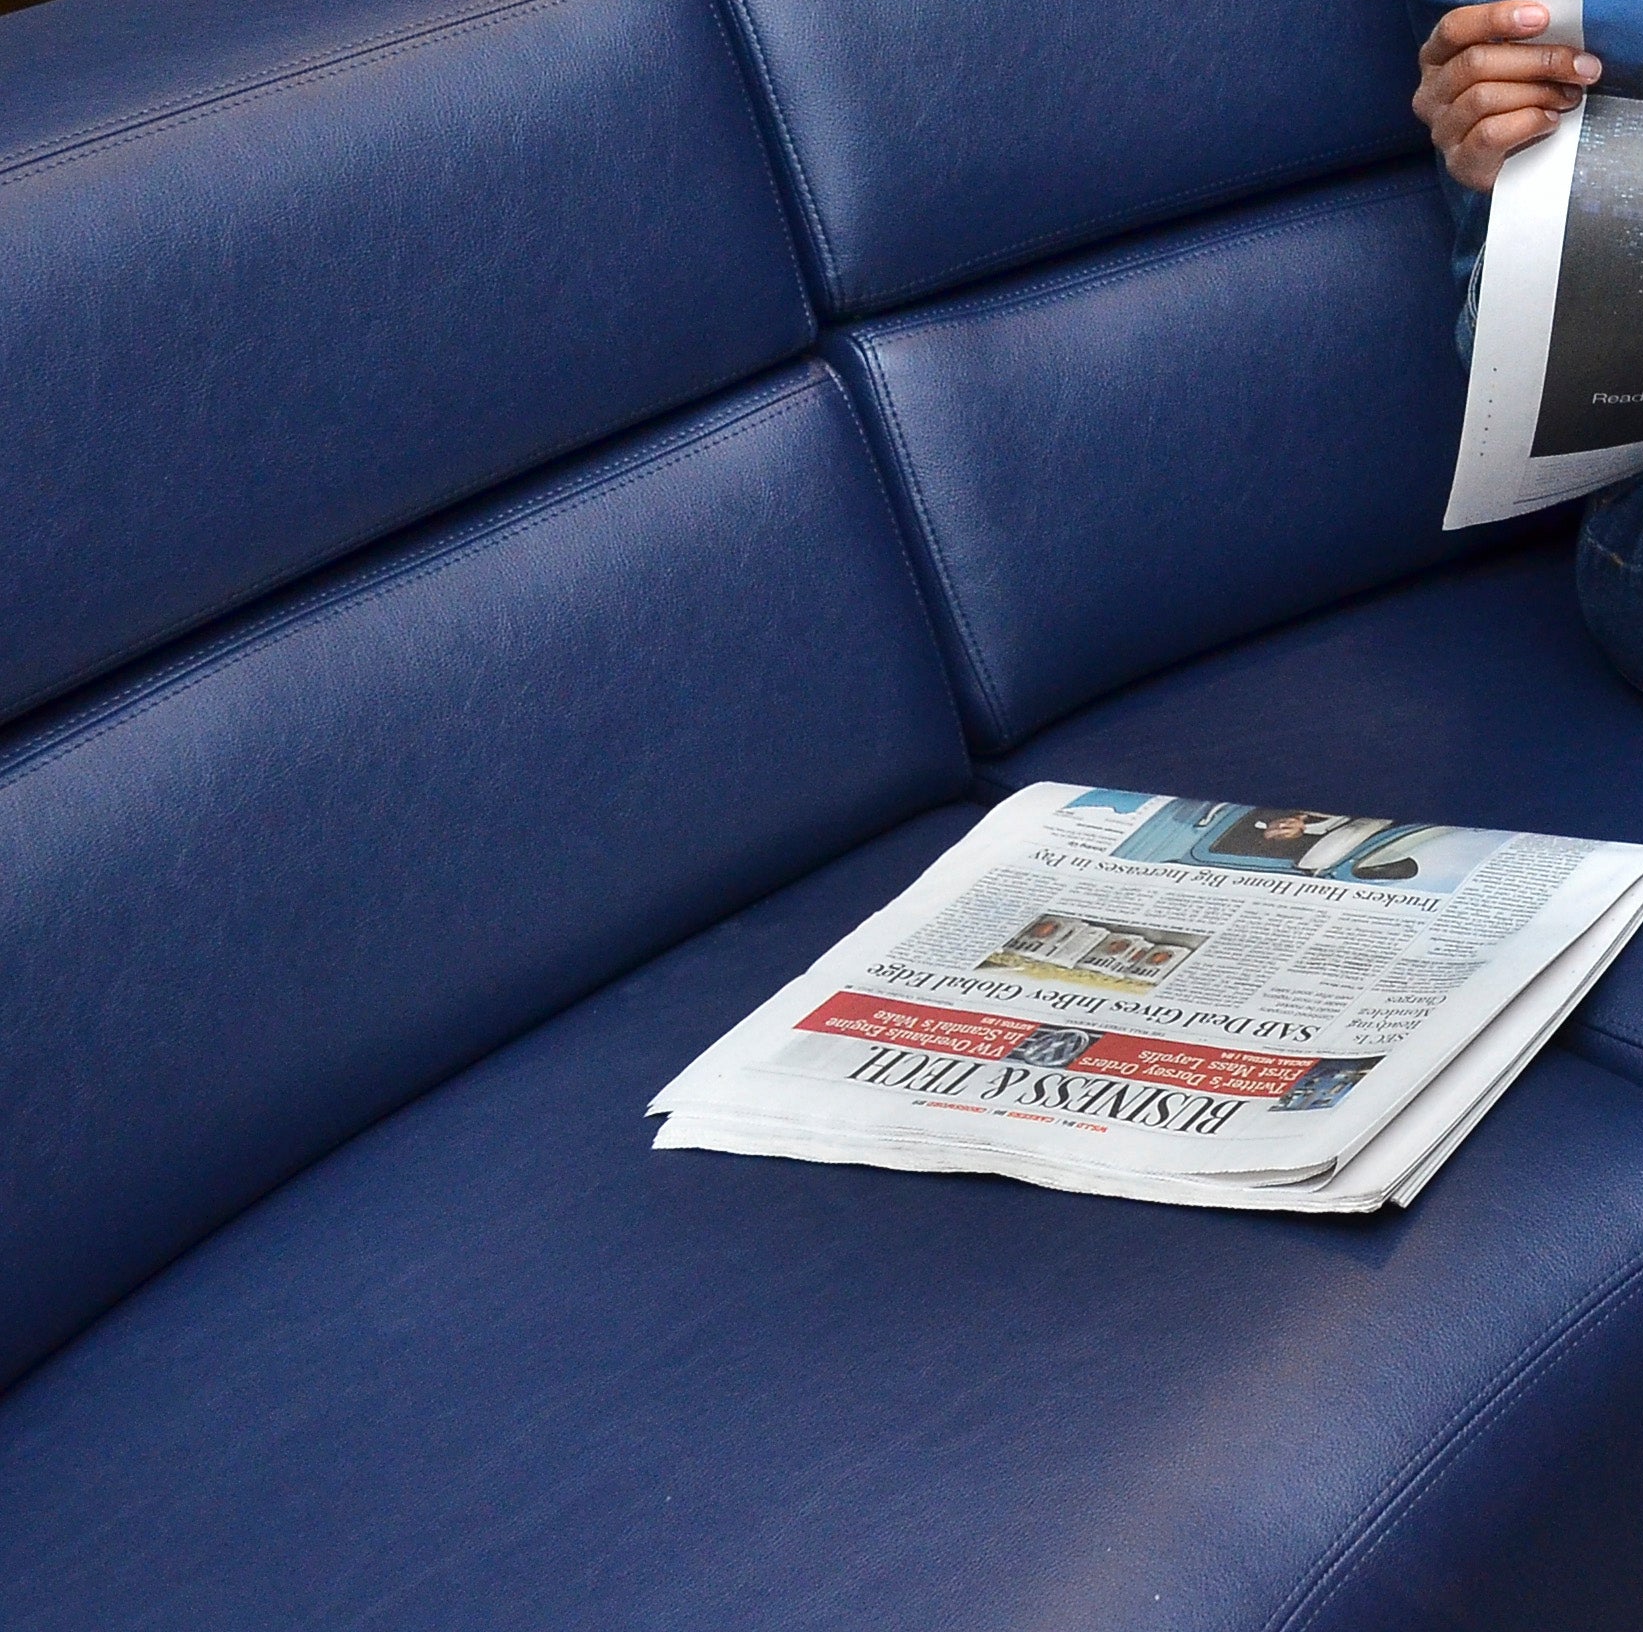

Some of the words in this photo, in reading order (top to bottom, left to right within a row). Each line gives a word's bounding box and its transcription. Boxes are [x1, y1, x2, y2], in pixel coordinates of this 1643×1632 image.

[1027, 849, 1066, 868] Pay
[1068, 858, 1092, 873] in
[1092, 861, 1193, 884] Increases
[1192, 869, 1230, 887] Big
[1231, 875, 1293, 894] Home
[1293, 882, 1350, 902] Haul
[1352, 889, 1442, 913] Truckers
[866, 962, 937, 989] Edge
[937, 973, 1024, 1003] Global
[1025, 987, 1108, 1014] InBev
[1384, 994, 1448, 1006] Charges
[873, 1009, 920, 1030] Wake
[1109, 999, 1183, 1026] Gives
[1356, 1007, 1436, 1018] Mondelez
[824, 1016, 886, 1036] Engine
[922, 1018, 1000, 1043] Scandal's
[1001, 1019, 1035, 1030] AUTOS
[1188, 1011, 1254, 1037] Deal
[1257, 1020, 1321, 1044] SAB
[1345, 1019, 1423, 1032] Readying
[886, 1026, 971, 1052] Overhauls
[1004, 1032, 1025, 1045] In
[1351, 1034, 1370, 1045] Is
[1373, 1032, 1410, 1045] SEC
[971, 1041, 1006, 1058] VW
[1242, 1053, 1275, 1064] MEDIA
[1078, 1056, 1140, 1076] Orders
[1137, 1049, 1200, 1071] Layoffs
[1207, 1059, 1250, 1076] Mass
[1277, 1057, 1314, 1068] SOCIAL
[844, 1045, 986, 1096] TECH.
[1144, 1063, 1208, 1086] Dorsey
[1252, 1065, 1304, 1082] First
[979, 1066, 1030, 1101] &
[1210, 1074, 1288, 1095] Twitter's
[927, 1100, 987, 1114] CROSSWORD
[1014, 1072, 1246, 1136] BUSINESS
[1007, 1111, 1055, 1124] CAREERS
